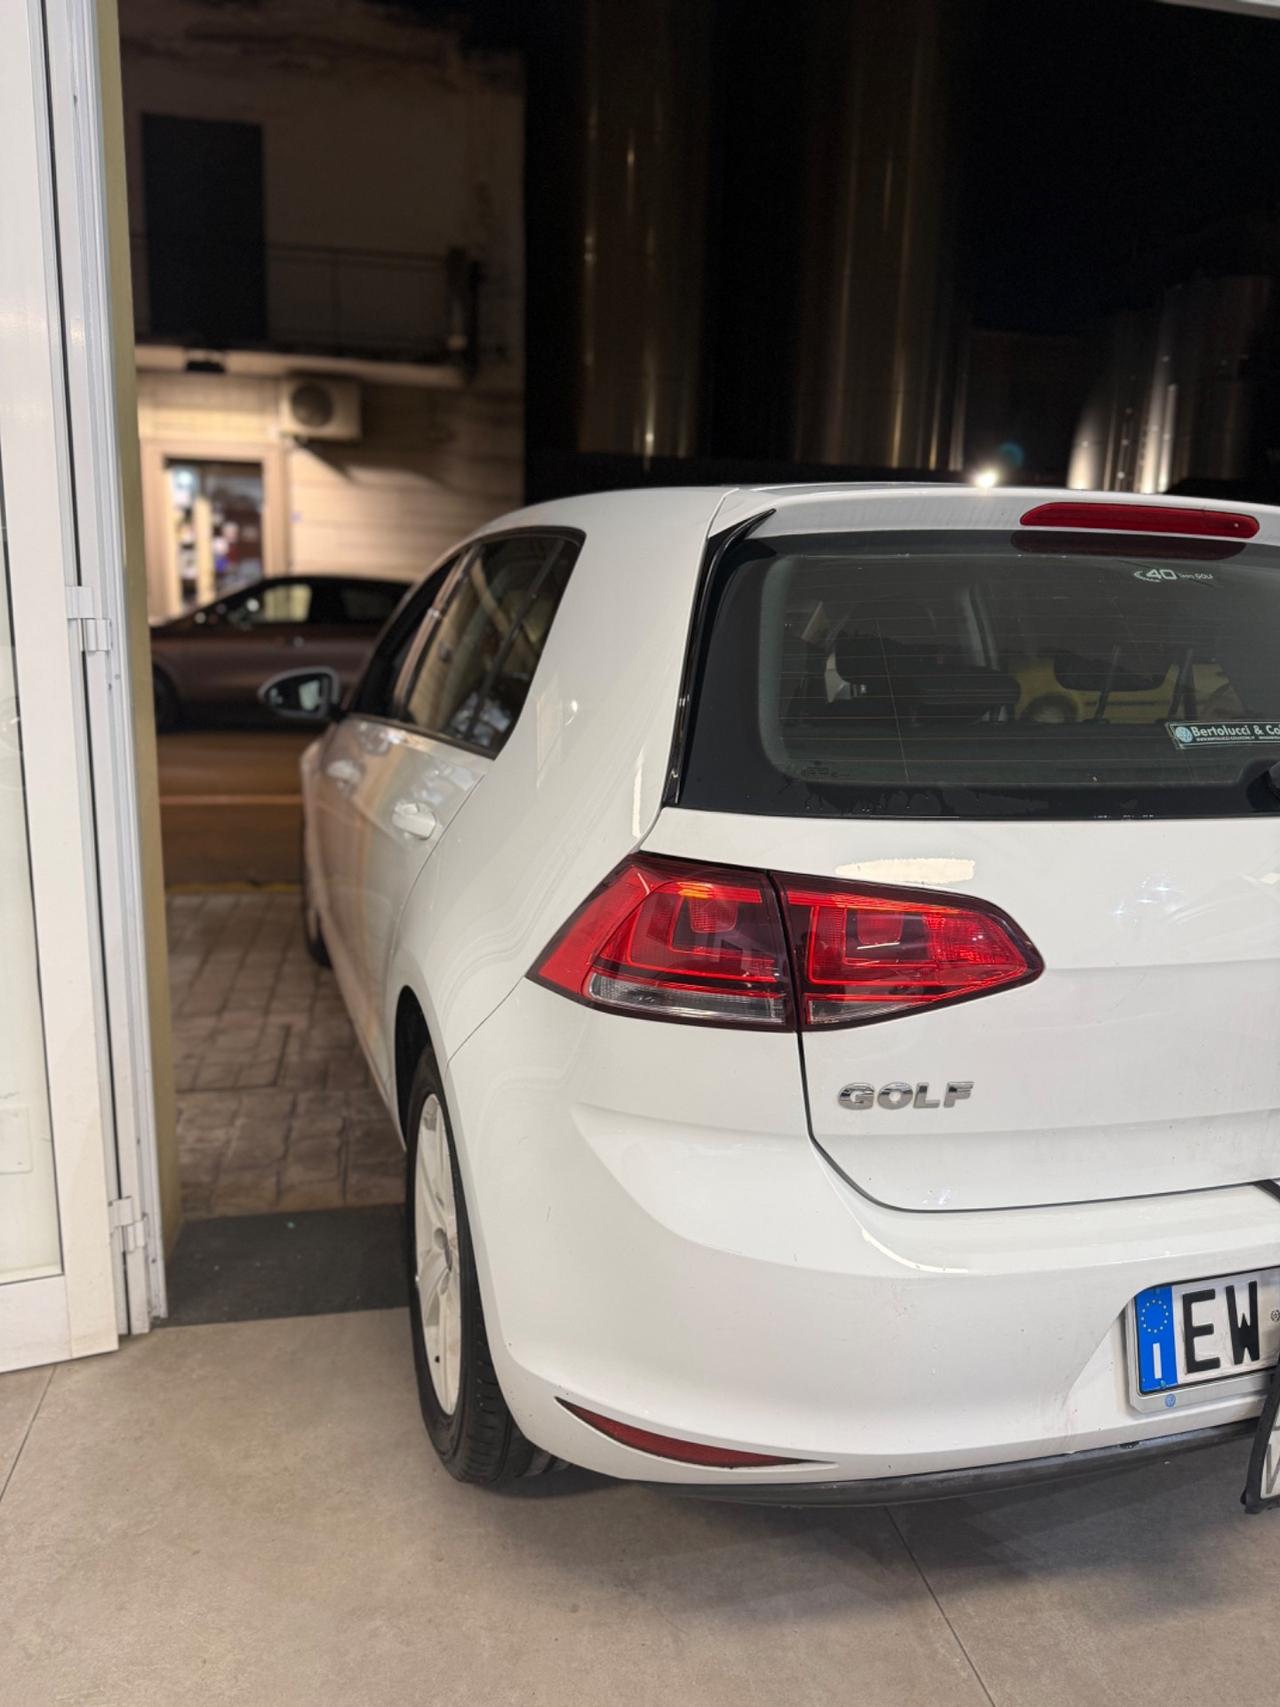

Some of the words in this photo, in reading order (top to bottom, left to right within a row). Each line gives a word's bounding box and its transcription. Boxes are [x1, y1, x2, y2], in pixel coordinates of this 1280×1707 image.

[1146, 569, 1177, 579] 40
[1190, 725, 1250, 737] Bertolucci
[1253, 725, 1264, 735] &
[1266, 724, 1280, 735] Co
[838, 1081, 975, 1110] GOLF
[1182, 1280, 1260, 1374] EW
